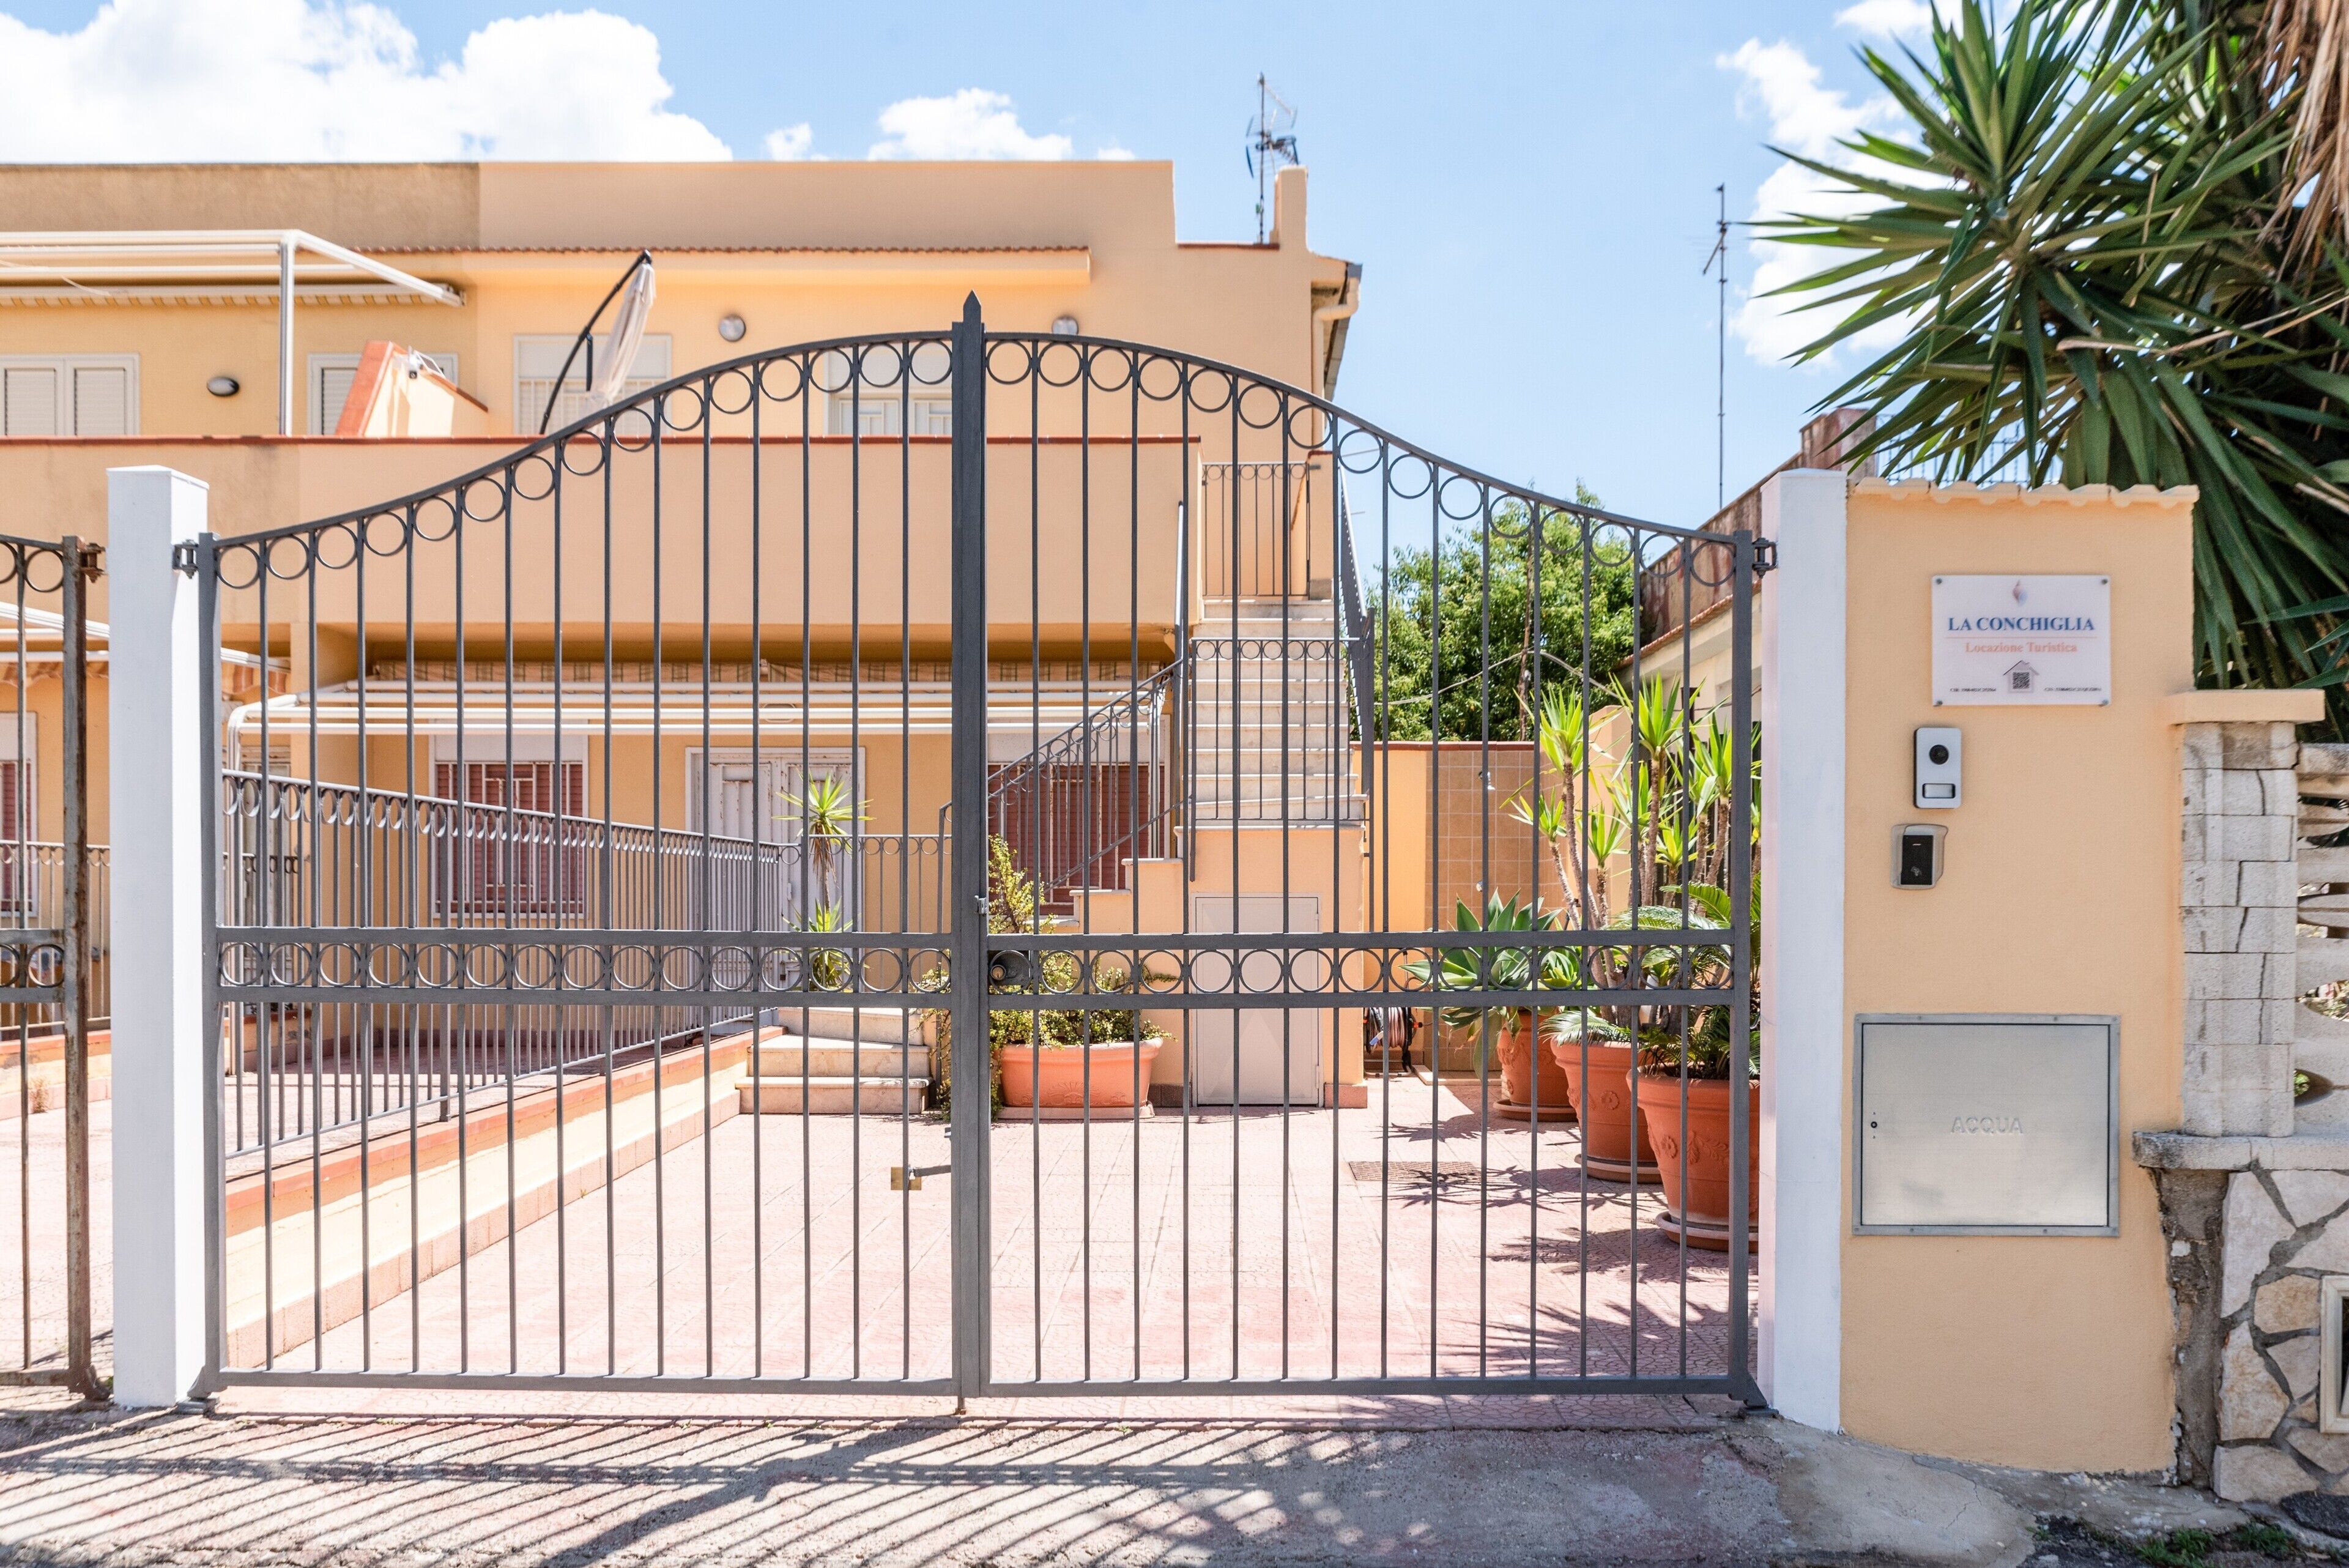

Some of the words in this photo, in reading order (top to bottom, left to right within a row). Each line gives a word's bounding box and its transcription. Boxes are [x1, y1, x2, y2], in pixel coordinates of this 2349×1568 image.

[1948, 617, 1972, 631] LA
[1976, 617, 2095, 631] CONCHIGLIA
[1965, 642, 2024, 653] Locazione
[2027, 642, 2077, 653] Turistica
[1951, 1116, 2023, 1134] ACQUA
